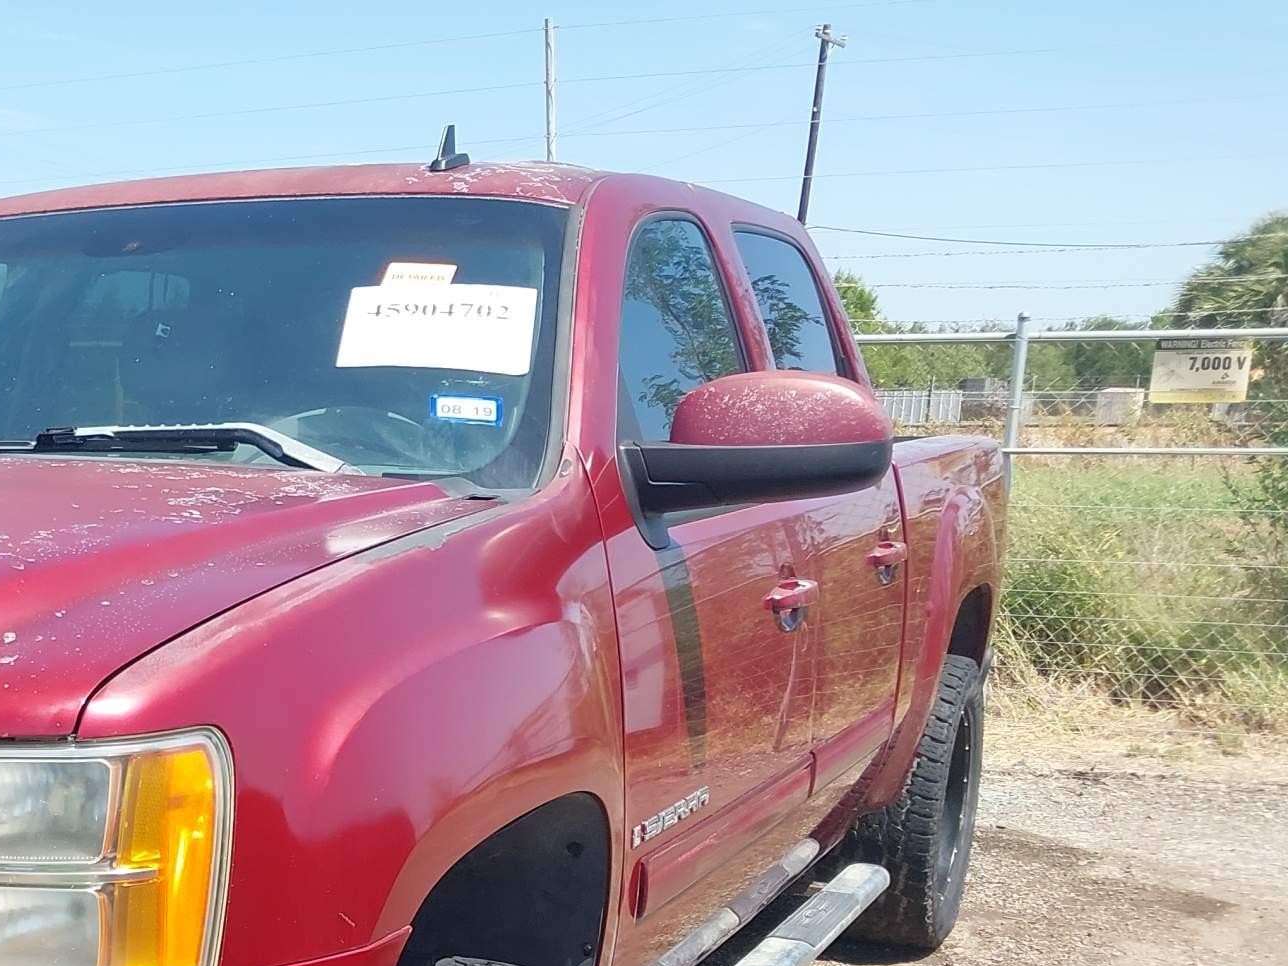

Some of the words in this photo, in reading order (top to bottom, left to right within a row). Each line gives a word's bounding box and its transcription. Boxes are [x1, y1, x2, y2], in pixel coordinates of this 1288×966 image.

[368, 303, 510, 319] 45904702
[1189, 357, 1231, 372] 7,000
[1237, 357, 1246, 370] V
[440, 404, 462, 415] 08
[473, 407, 493, 417] 19
[642, 785, 709, 841] SIERRA
